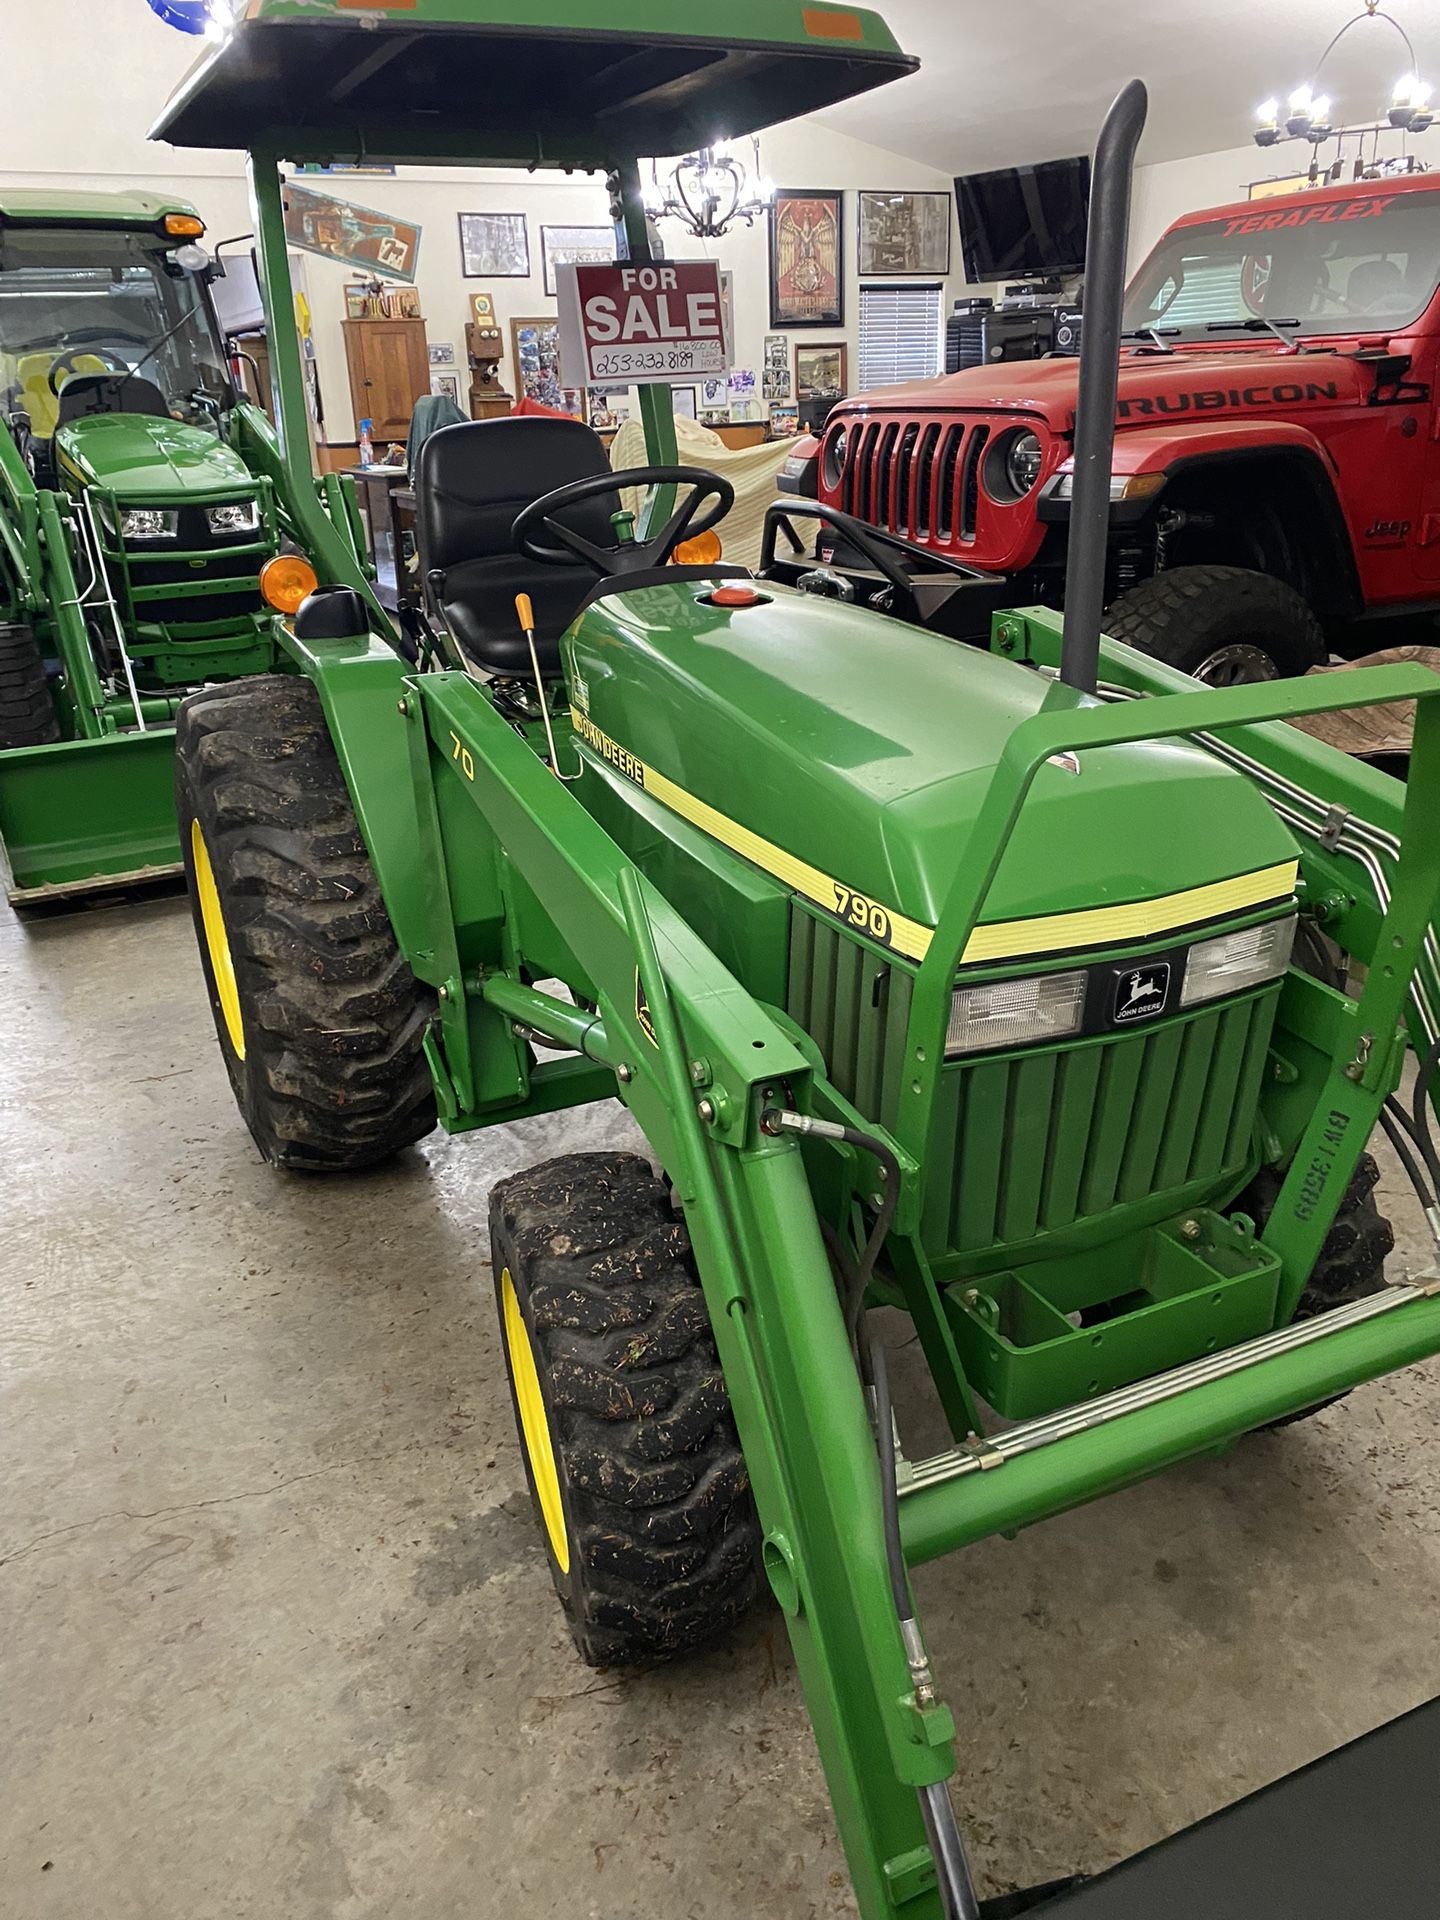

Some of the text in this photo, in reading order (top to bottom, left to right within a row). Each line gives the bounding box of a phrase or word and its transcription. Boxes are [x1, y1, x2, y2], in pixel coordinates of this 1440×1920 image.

[1222, 197, 1396, 238] TERAFLEX
[621, 268, 678, 292] FOR
[585, 293, 720, 341] SALE
[1116, 382, 1338, 418] RUBICON
[1364, 517, 1412, 541] Jeep
[449, 729, 475, 783] 70
[577, 716, 644, 786] JOHN DEERE
[833, 882, 889, 939] 790
[1116, 1002, 1161, 1019] JOHN DEERE
